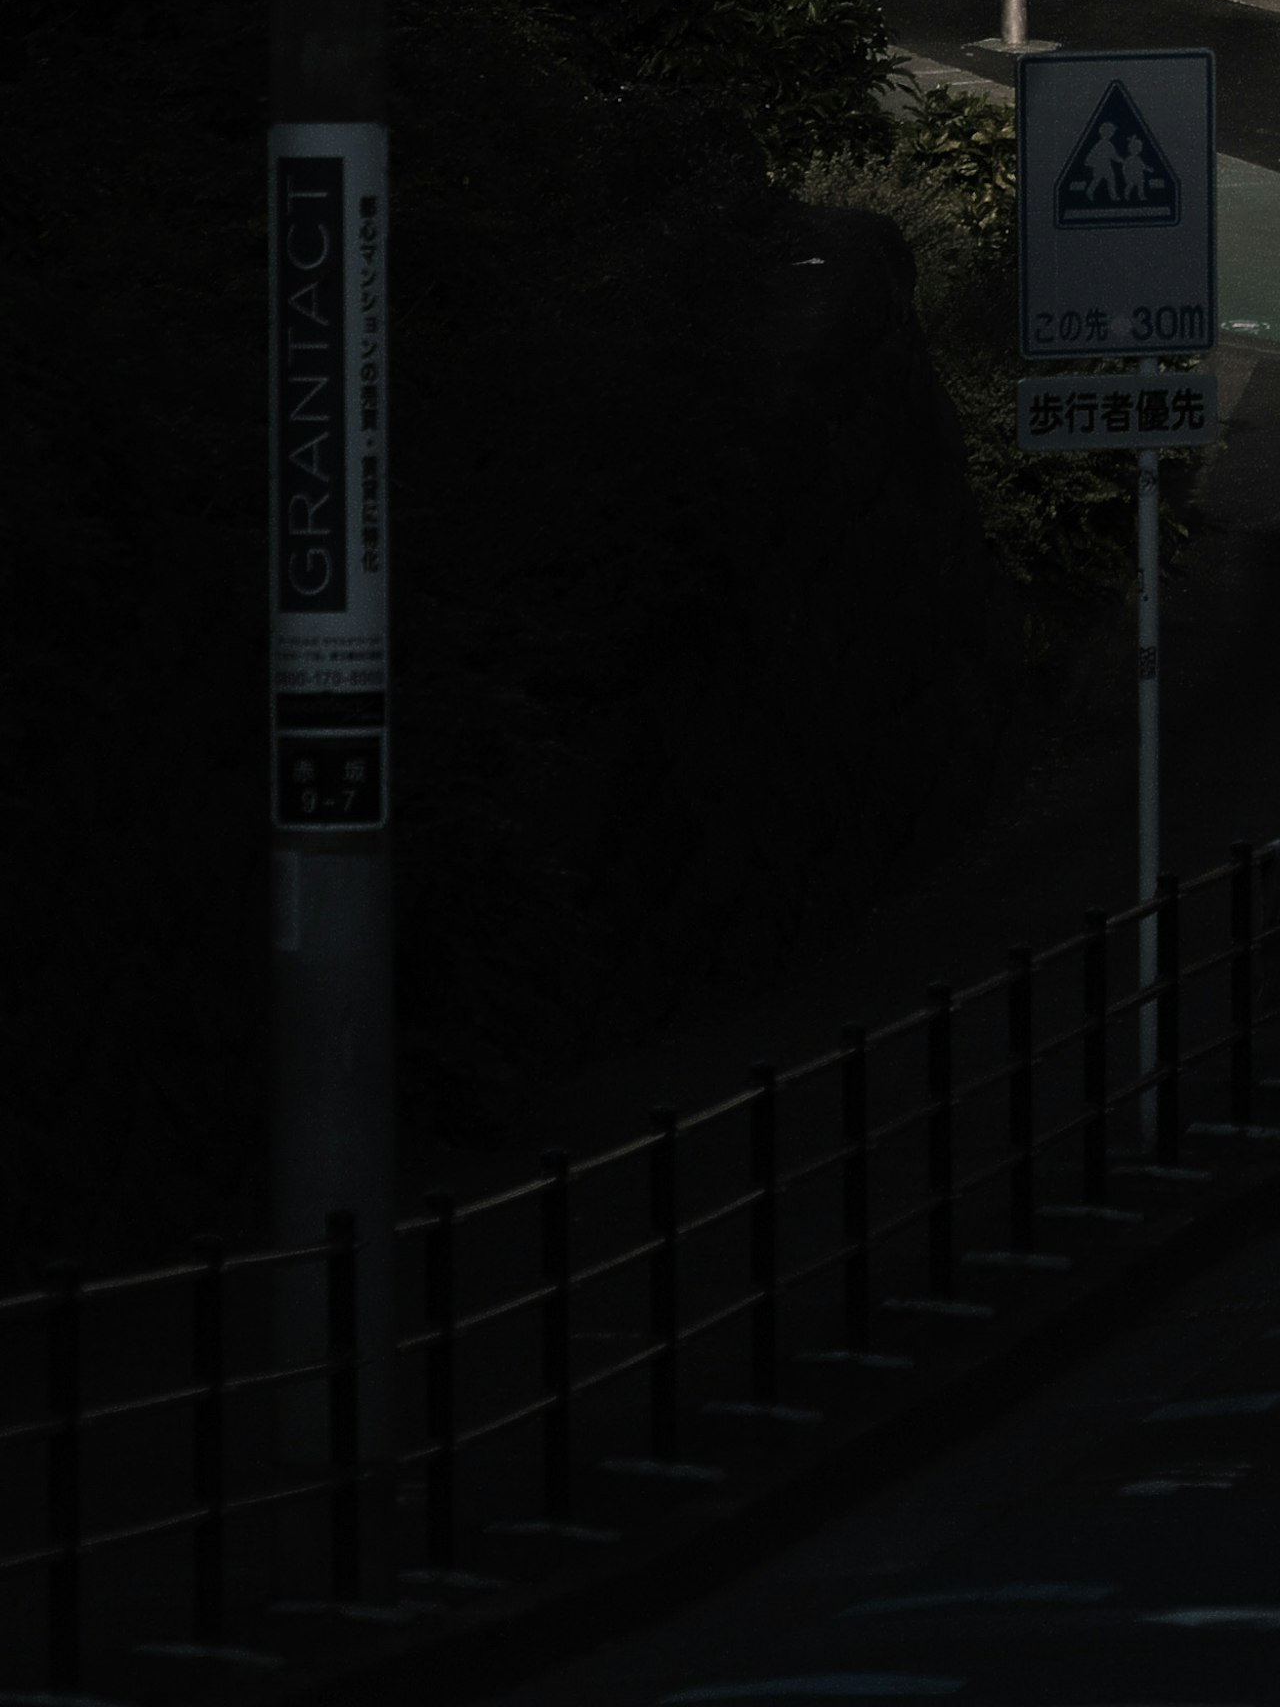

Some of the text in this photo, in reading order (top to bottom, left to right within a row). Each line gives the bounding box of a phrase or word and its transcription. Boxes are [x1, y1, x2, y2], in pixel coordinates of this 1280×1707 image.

[1035, 305, 1205, 343] この先 30m
[287, 174, 333, 598] GRANTACT
[1029, 389, 1205, 435] 歩行者優先
[301, 789, 357, 814] 9-7
